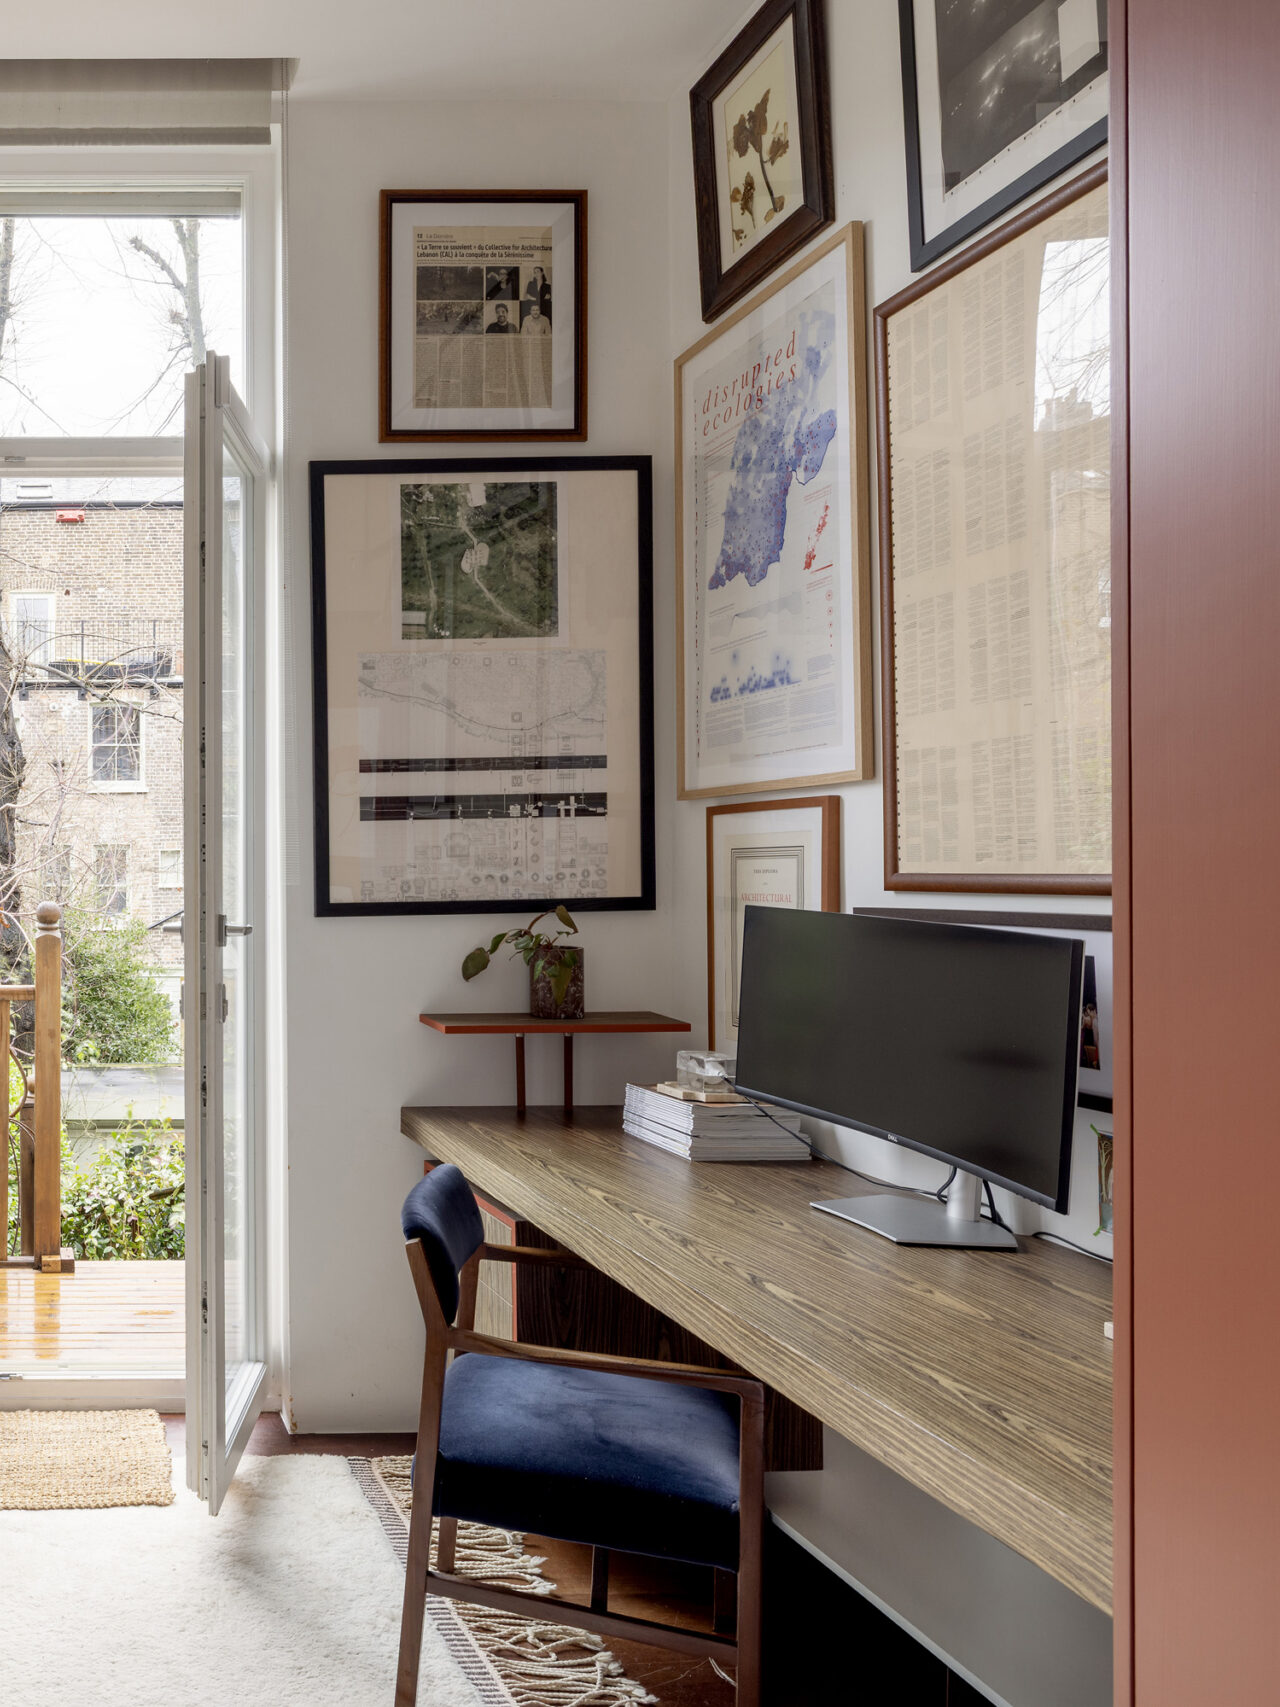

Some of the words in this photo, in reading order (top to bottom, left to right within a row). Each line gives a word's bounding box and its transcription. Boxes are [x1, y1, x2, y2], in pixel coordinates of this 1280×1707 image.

[465, 251, 489, 259] conquête
[702, 329, 795, 414] disrupted
[703, 363, 796, 436] ecologies
[741, 892, 793, 903] ARCHITECTURAL
